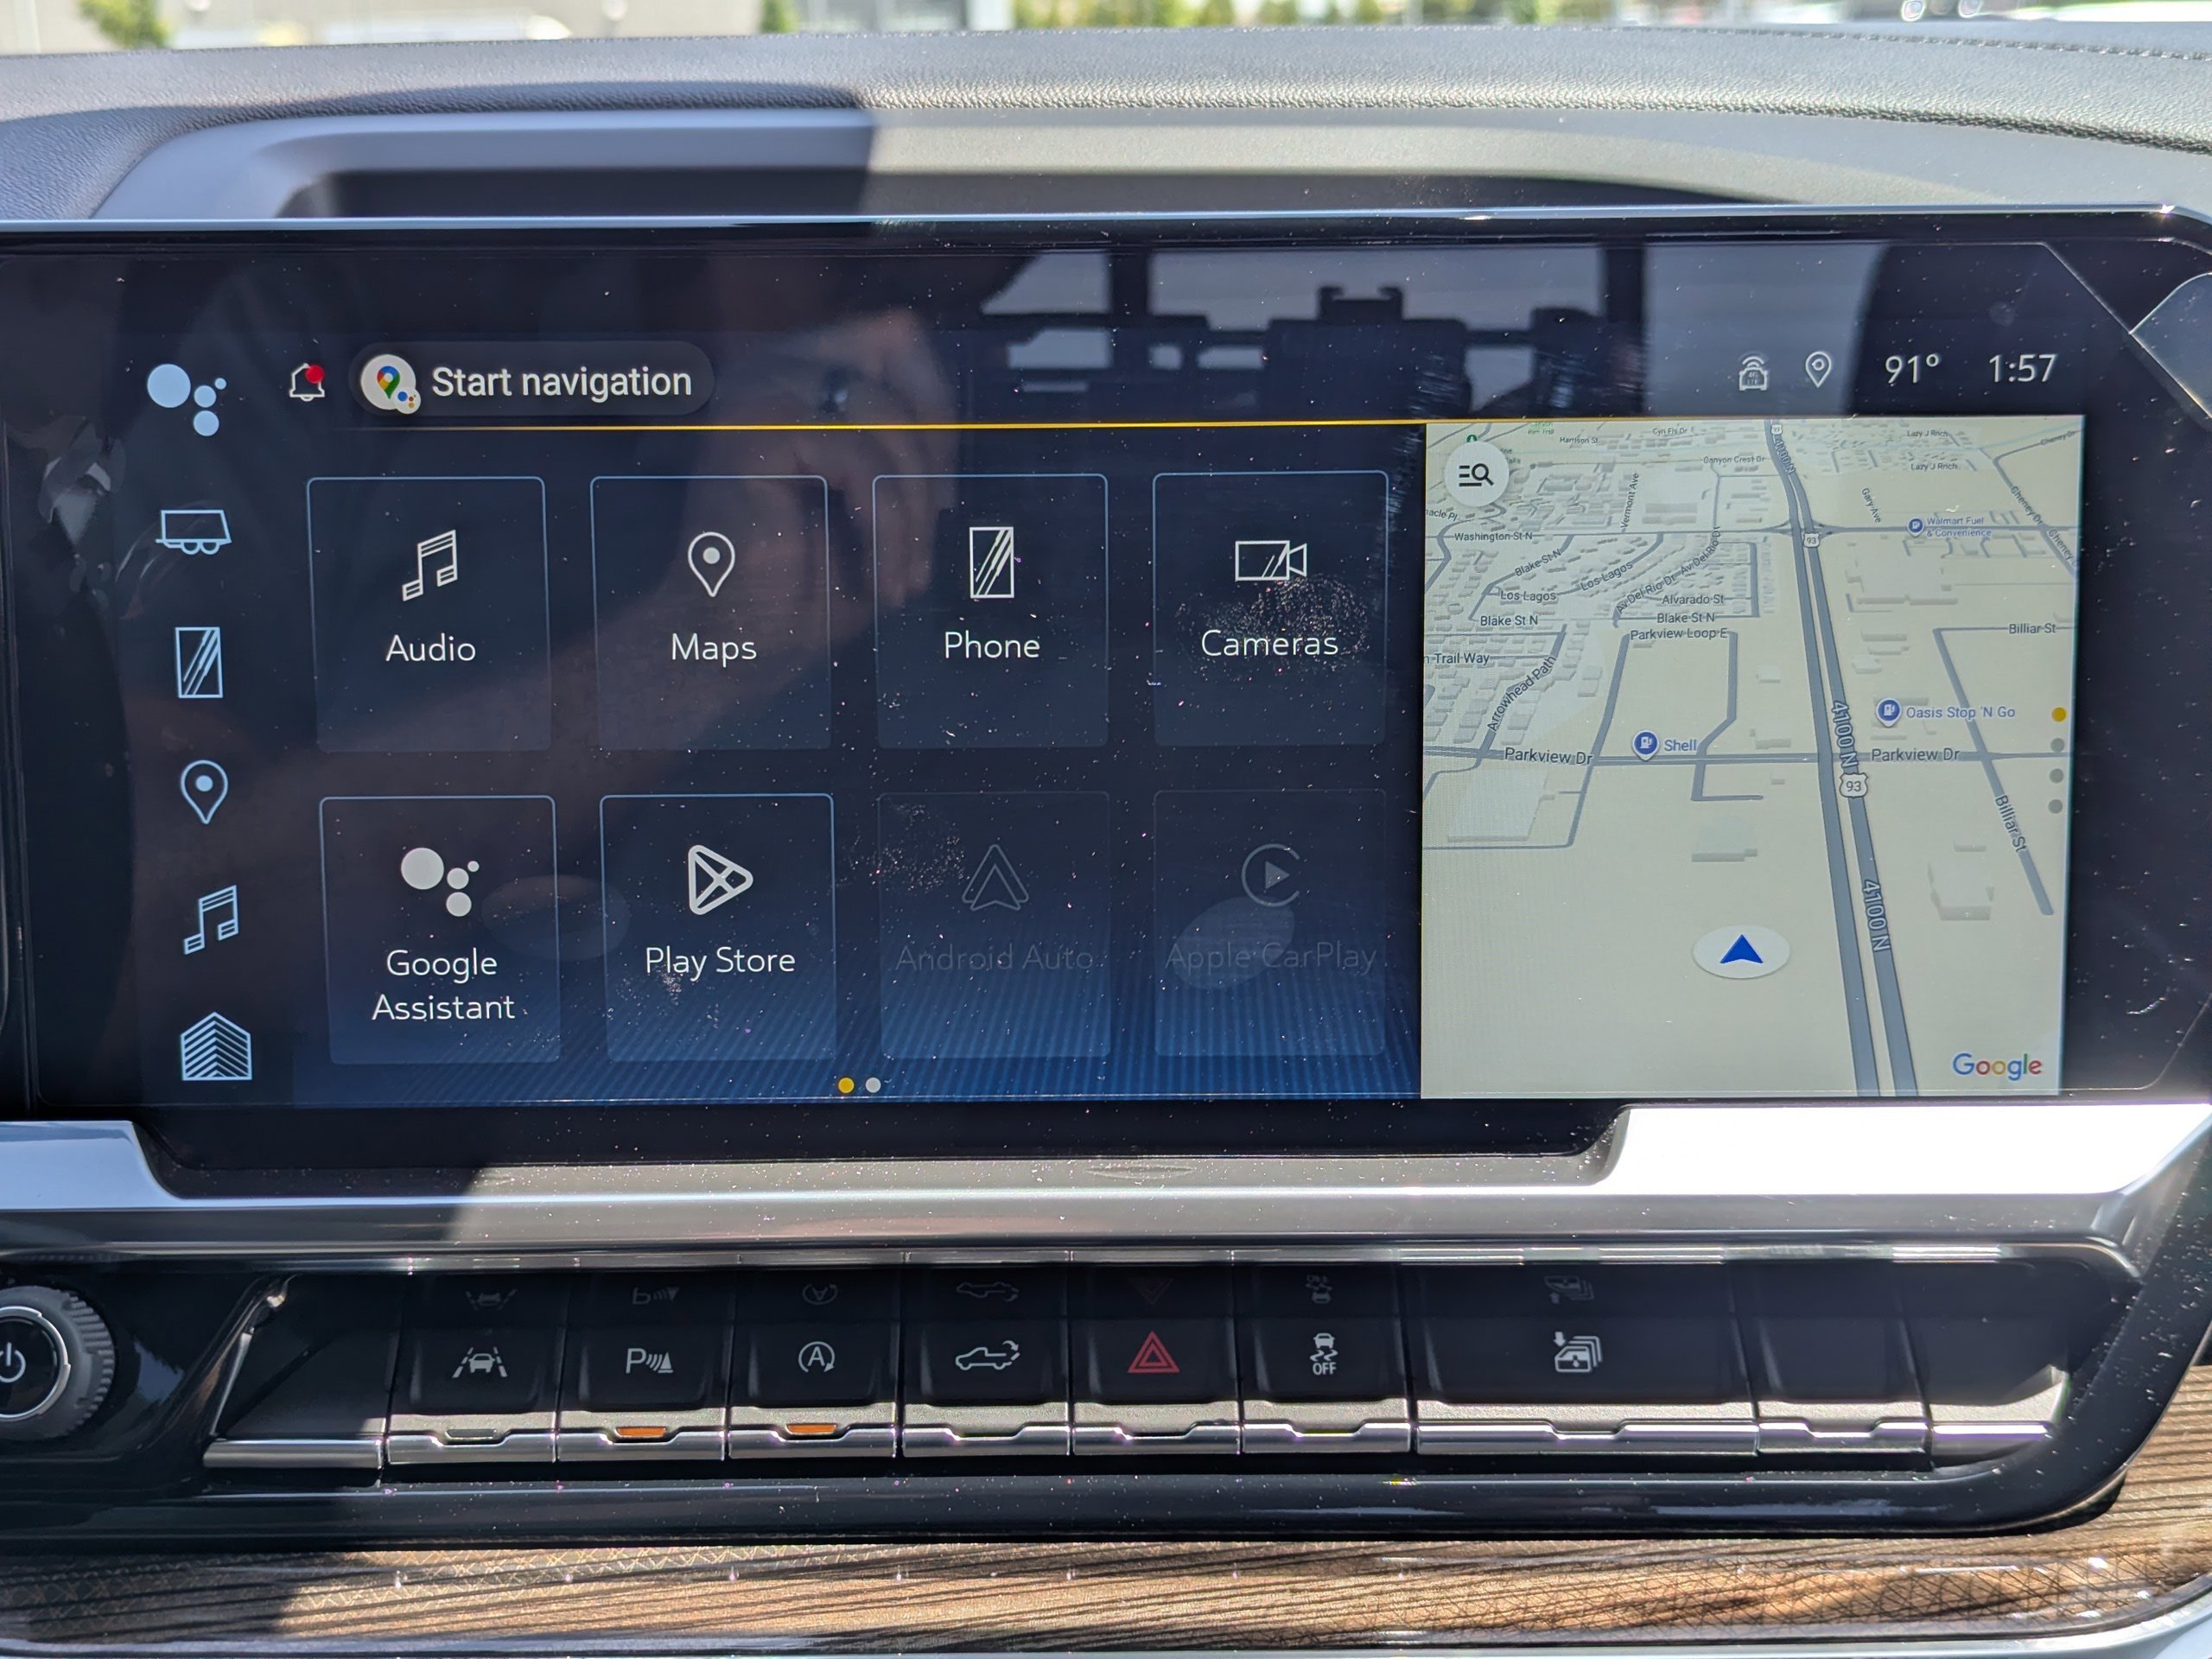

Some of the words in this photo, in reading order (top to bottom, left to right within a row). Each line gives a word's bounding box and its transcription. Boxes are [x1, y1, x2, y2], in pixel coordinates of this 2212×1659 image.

[1885, 353, 1940, 384] 91°
[1988, 353, 2056, 383] 1:57
[432, 366, 512, 397] Start
[522, 365, 691, 403] navigation
[1620, 490, 1636, 529] Vermont
[1629, 473, 1639, 491] Ave
[1862, 487, 1875, 509] Gary
[1870, 506, 1881, 523] Ave
[2011, 486, 2034, 516] Cheney
[2033, 514, 2043, 524] Dr
[1448, 512, 1459, 521] Pl
[1454, 532, 1510, 543] Washington
[1512, 531, 1522, 540] St
[1525, 531, 1533, 540] N
[2049, 529, 2074, 561] Cheney
[1515, 557, 1542, 577] Blake
[1540, 553, 1553, 567] St
[1552, 549, 1562, 560] N
[1681, 563, 1692, 575] Av
[1693, 553, 1708, 567] Del
[1706, 540, 1719, 554] Rio
[1580, 579, 1598, 593] Los
[1596, 561, 1633, 585] Lagos
[1501, 591, 1521, 601] Los
[1523, 591, 1556, 602] Lagos
[1617, 601, 1628, 613] Av
[1627, 588, 1644, 604] Del
[1645, 582, 1662, 594] Rio
[1663, 574, 1677, 586] Dr
[1662, 594, 1710, 604] Alvarado
[1713, 594, 1725, 604] St
[1480, 615, 1512, 626] Blake
[1515, 615, 1527, 626] St
[1529, 615, 1538, 626] N
[1657, 613, 1688, 622] Blake
[1692, 613, 1703, 622] St
[1706, 613, 1715, 622] N
[2009, 623, 2043, 634] Billiar
[2045, 623, 2056, 633] St
[385, 632, 476, 662] Audio
[944, 632, 1040, 659] Phone
[1201, 629, 1338, 658] Cameras
[1630, 629, 1684, 641] Parkview
[1687, 628, 1717, 642] Loop
[1719, 628, 1728, 639] E
[671, 633, 757, 668] Maps
[1434, 653, 1460, 664] Trail
[1461, 653, 1491, 665] Way
[1487, 674, 1535, 731] Arrowhead
[1532, 656, 1557, 680] Path
[1832, 701, 1855, 749] 4100
[1906, 707, 1942, 719] Oasis
[1947, 707, 1975, 722] Stop
[1997, 707, 2016, 718] Go
[1504, 747, 1572, 764] Parkview
[1575, 753, 1593, 765] Dr
[1664, 739, 1697, 752] Shell
[1840, 751, 1858, 768] N
[1872, 748, 1938, 761] Parkview
[1943, 748, 1960, 760] Dr
[1846, 780, 1862, 792] 93
[1995, 795, 2019, 835] Billiar
[2012, 836, 2027, 852] St
[1863, 880, 1886, 930] 4100
[1872, 934, 1891, 951] N
[386, 948, 498, 983] Google
[646, 946, 707, 982] Play
[716, 947, 796, 974] Store
[895, 944, 1014, 972] Android
[1021, 944, 1093, 971] Auto
[1165, 943, 1250, 977] Apple
[1261, 942, 1377, 976] CarPlay
[372, 994, 515, 1020] Assistant
[1953, 1052, 2042, 1081] Google
[1313, 1362, 1337, 1376] OFF
